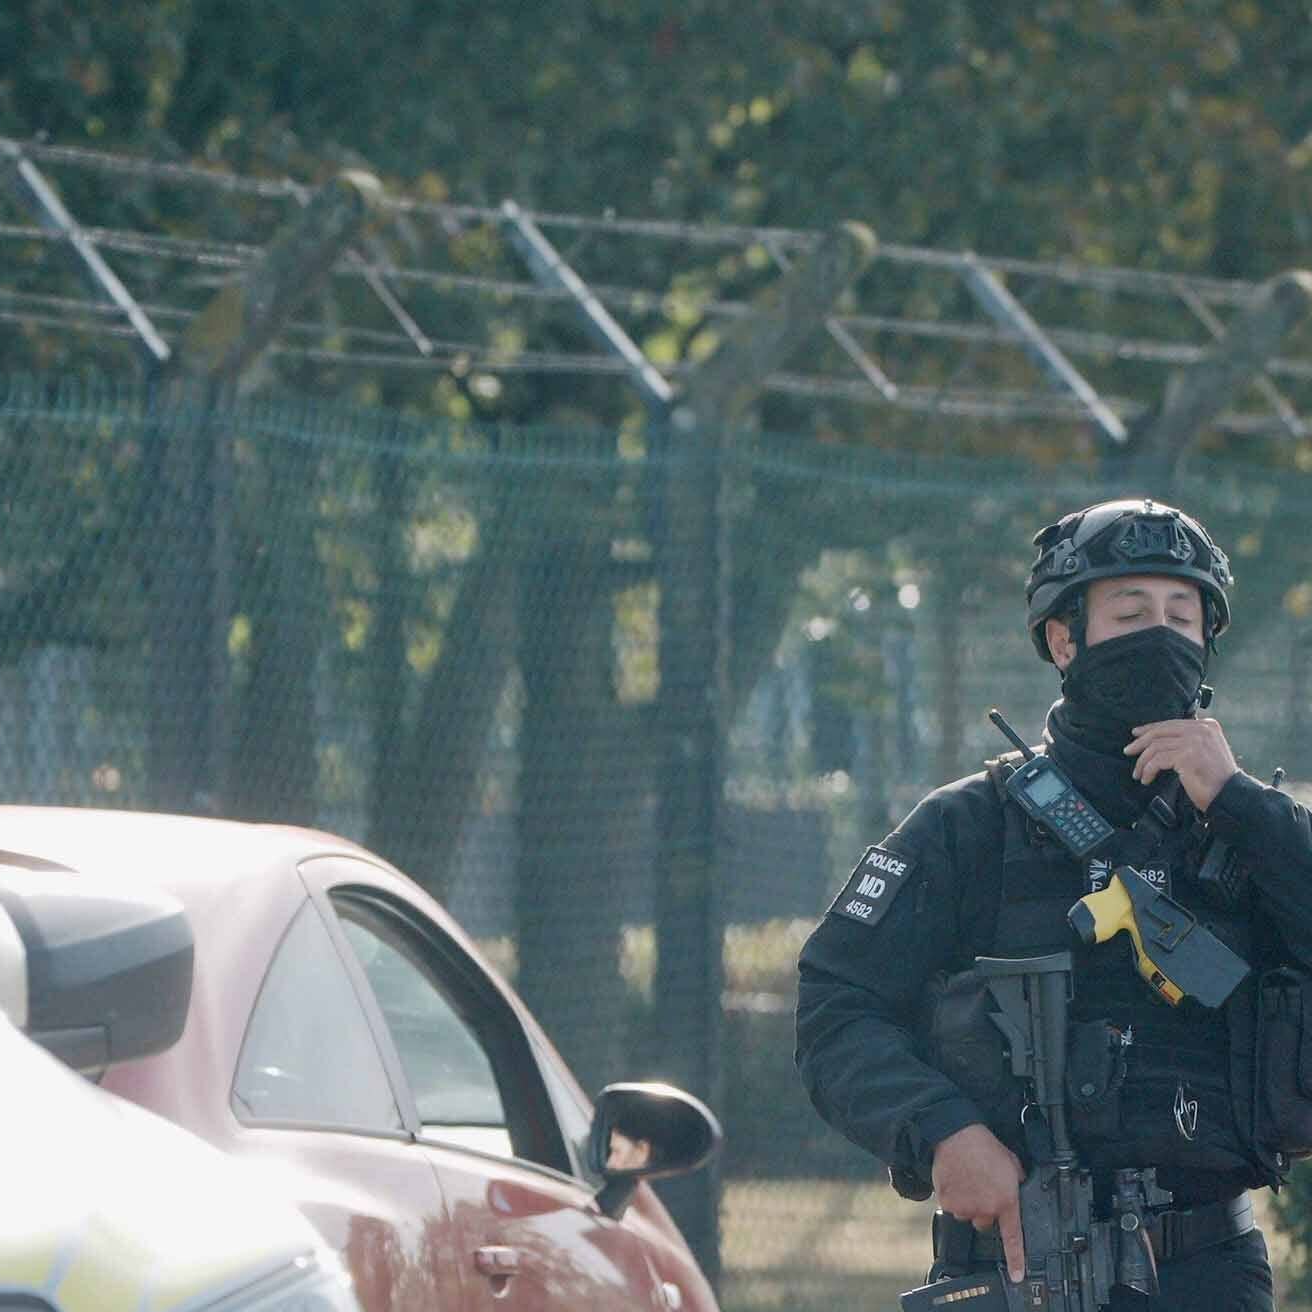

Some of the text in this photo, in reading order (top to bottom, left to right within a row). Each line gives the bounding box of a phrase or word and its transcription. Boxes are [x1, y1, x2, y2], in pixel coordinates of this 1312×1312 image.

[865, 852, 907, 877] POLICE
[855, 873, 886, 899] MD
[1139, 869, 1166, 883] 582
[846, 899, 873, 919] 4582
